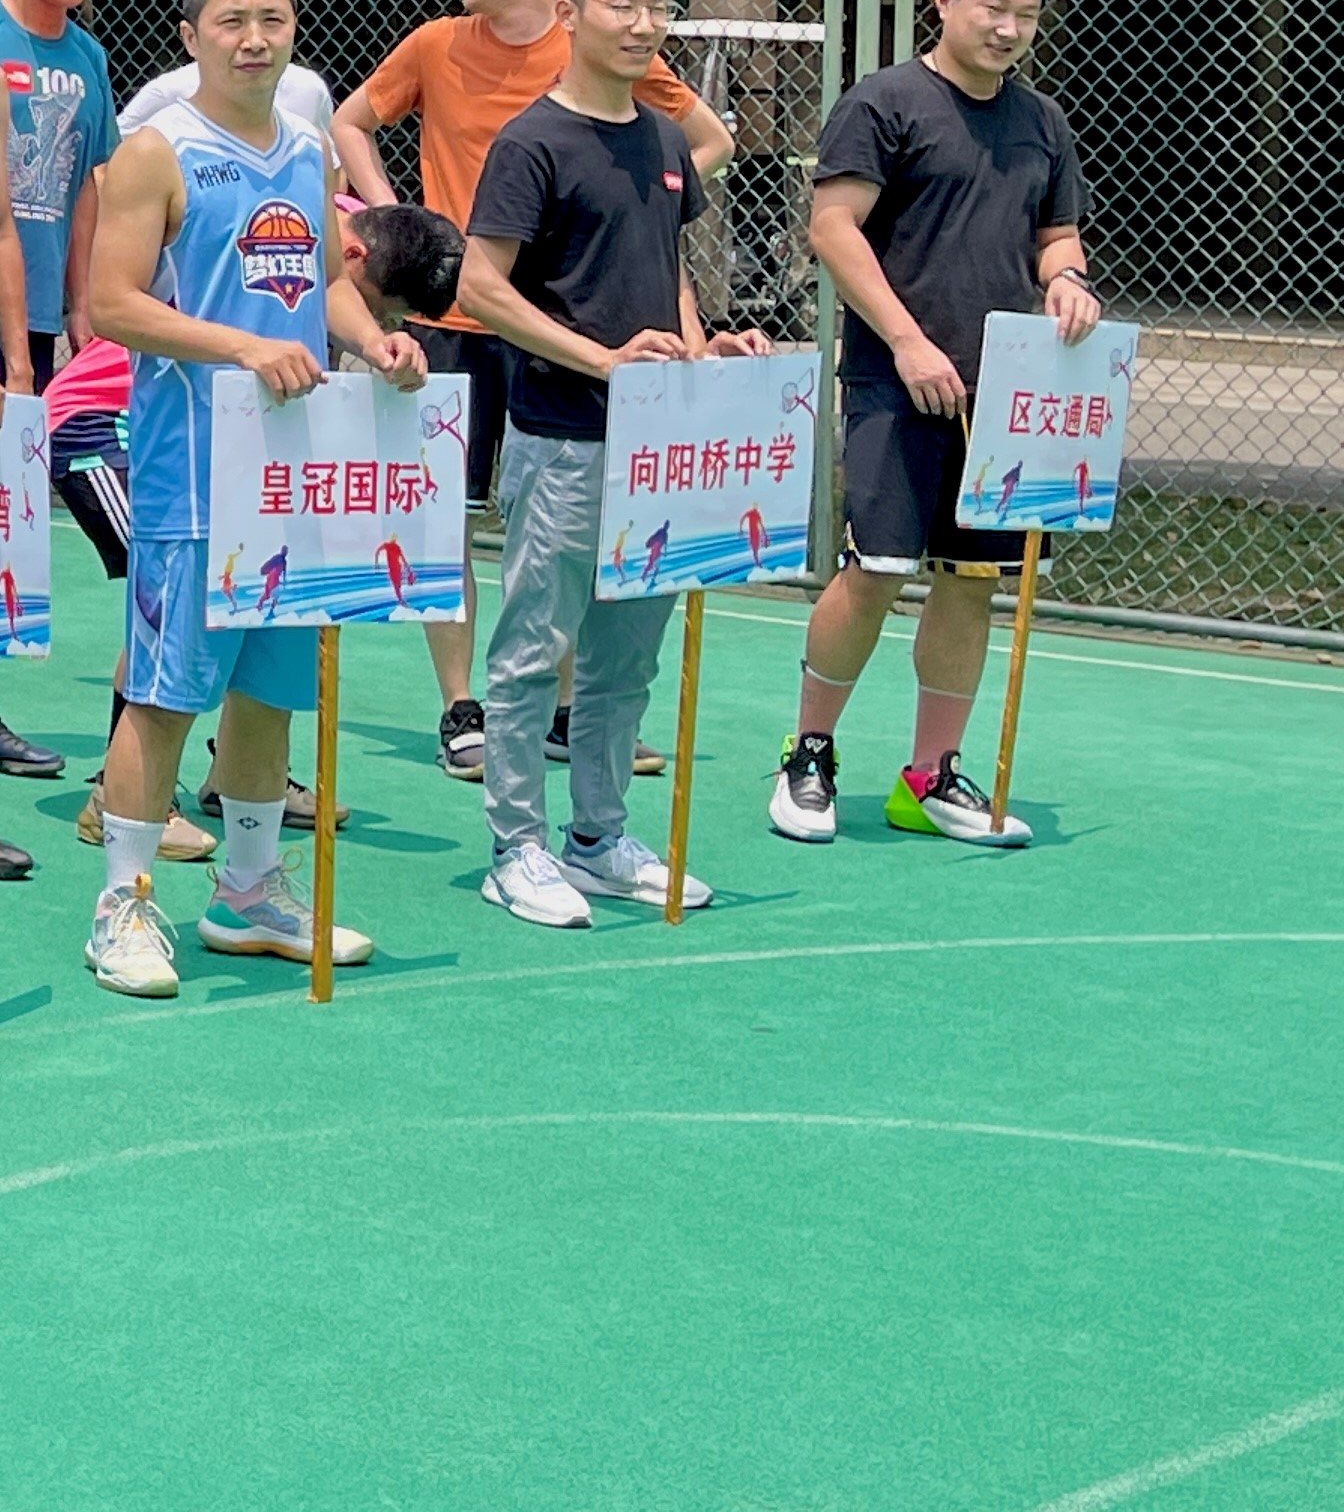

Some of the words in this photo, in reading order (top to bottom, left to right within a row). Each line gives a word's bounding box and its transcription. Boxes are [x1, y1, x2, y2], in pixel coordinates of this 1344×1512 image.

[193, 161, 241, 189] MHWG
[1009, 391, 1105, 438] 区交通局
[259, 461, 422, 515] 皇冠国际
[629, 433, 796, 496] 向阳桥中学
